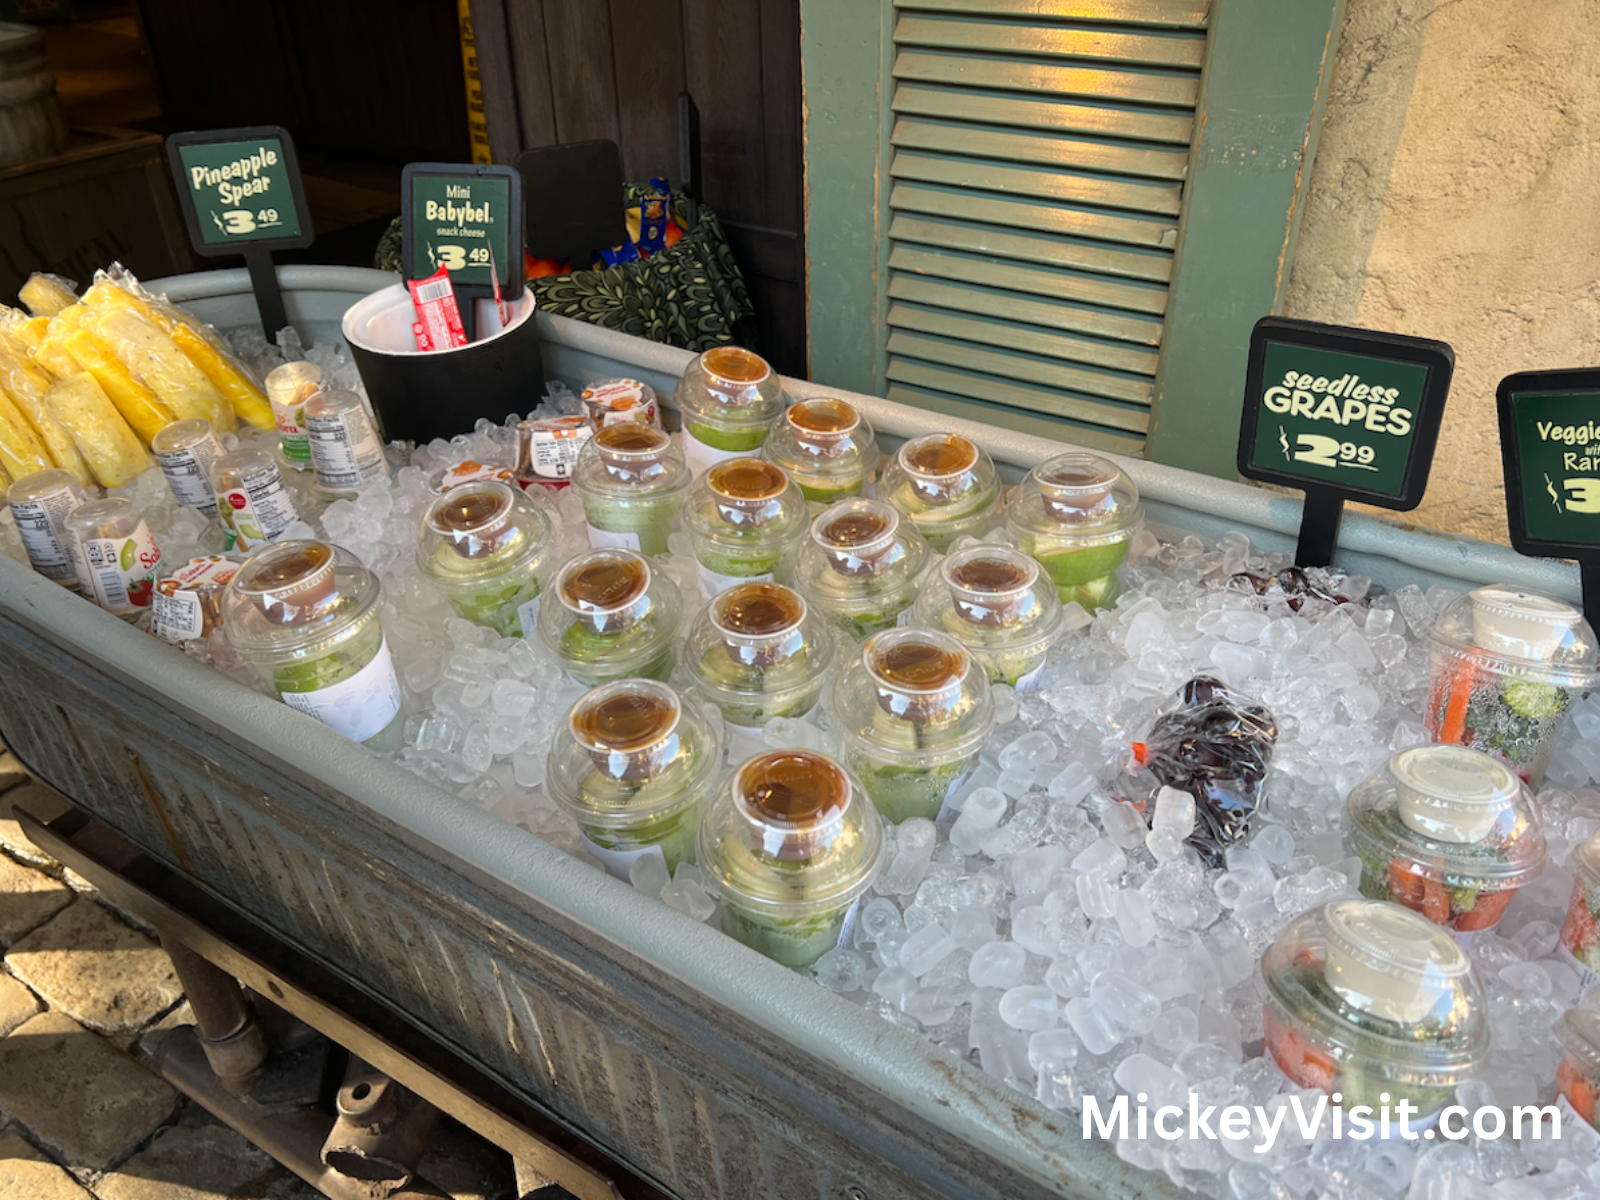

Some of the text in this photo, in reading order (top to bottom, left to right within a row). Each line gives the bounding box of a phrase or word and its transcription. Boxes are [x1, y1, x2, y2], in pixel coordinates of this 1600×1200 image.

[191, 146, 278, 190] Pineapple
[217, 176, 271, 207] Spear
[446, 185, 471, 199] Mini
[425, 200, 490, 228] Babybel
[436, 227, 486, 238] snack cheese
[1282, 370, 1400, 405] seedless
[1263, 386, 1413, 436] GRAPES
